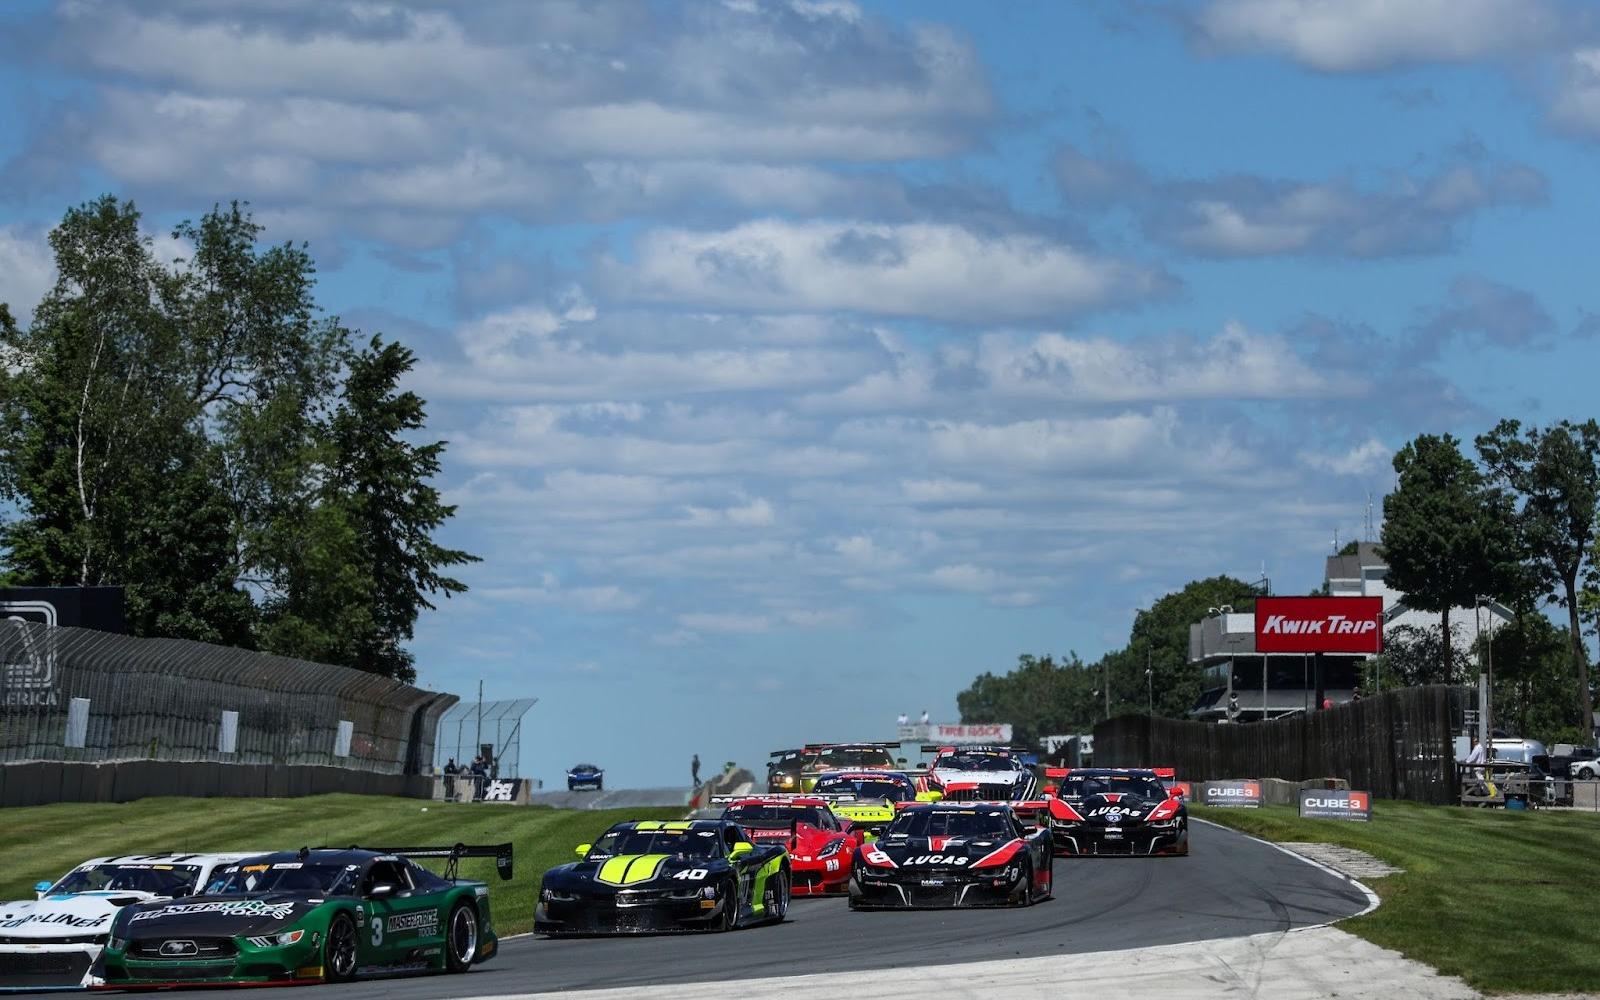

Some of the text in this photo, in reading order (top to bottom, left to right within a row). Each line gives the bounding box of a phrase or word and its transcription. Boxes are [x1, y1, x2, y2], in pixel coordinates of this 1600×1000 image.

[1262, 615, 1376, 634] KWIK TRIP
[1207, 787, 1253, 797] CUBE3
[1305, 797, 1361, 809] CUBE3
[1088, 806, 1142, 817] LUCAS
[1156, 809, 1171, 817] 7
[866, 851, 892, 864] 8
[903, 855, 969, 866] LUCAS
[673, 869, 709, 880] 40
[1010, 867, 1018, 881] 8
[40, 913, 111, 928] LINER
[371, 917, 383, 947] 3
[418, 926, 437, 938] TOOLS
